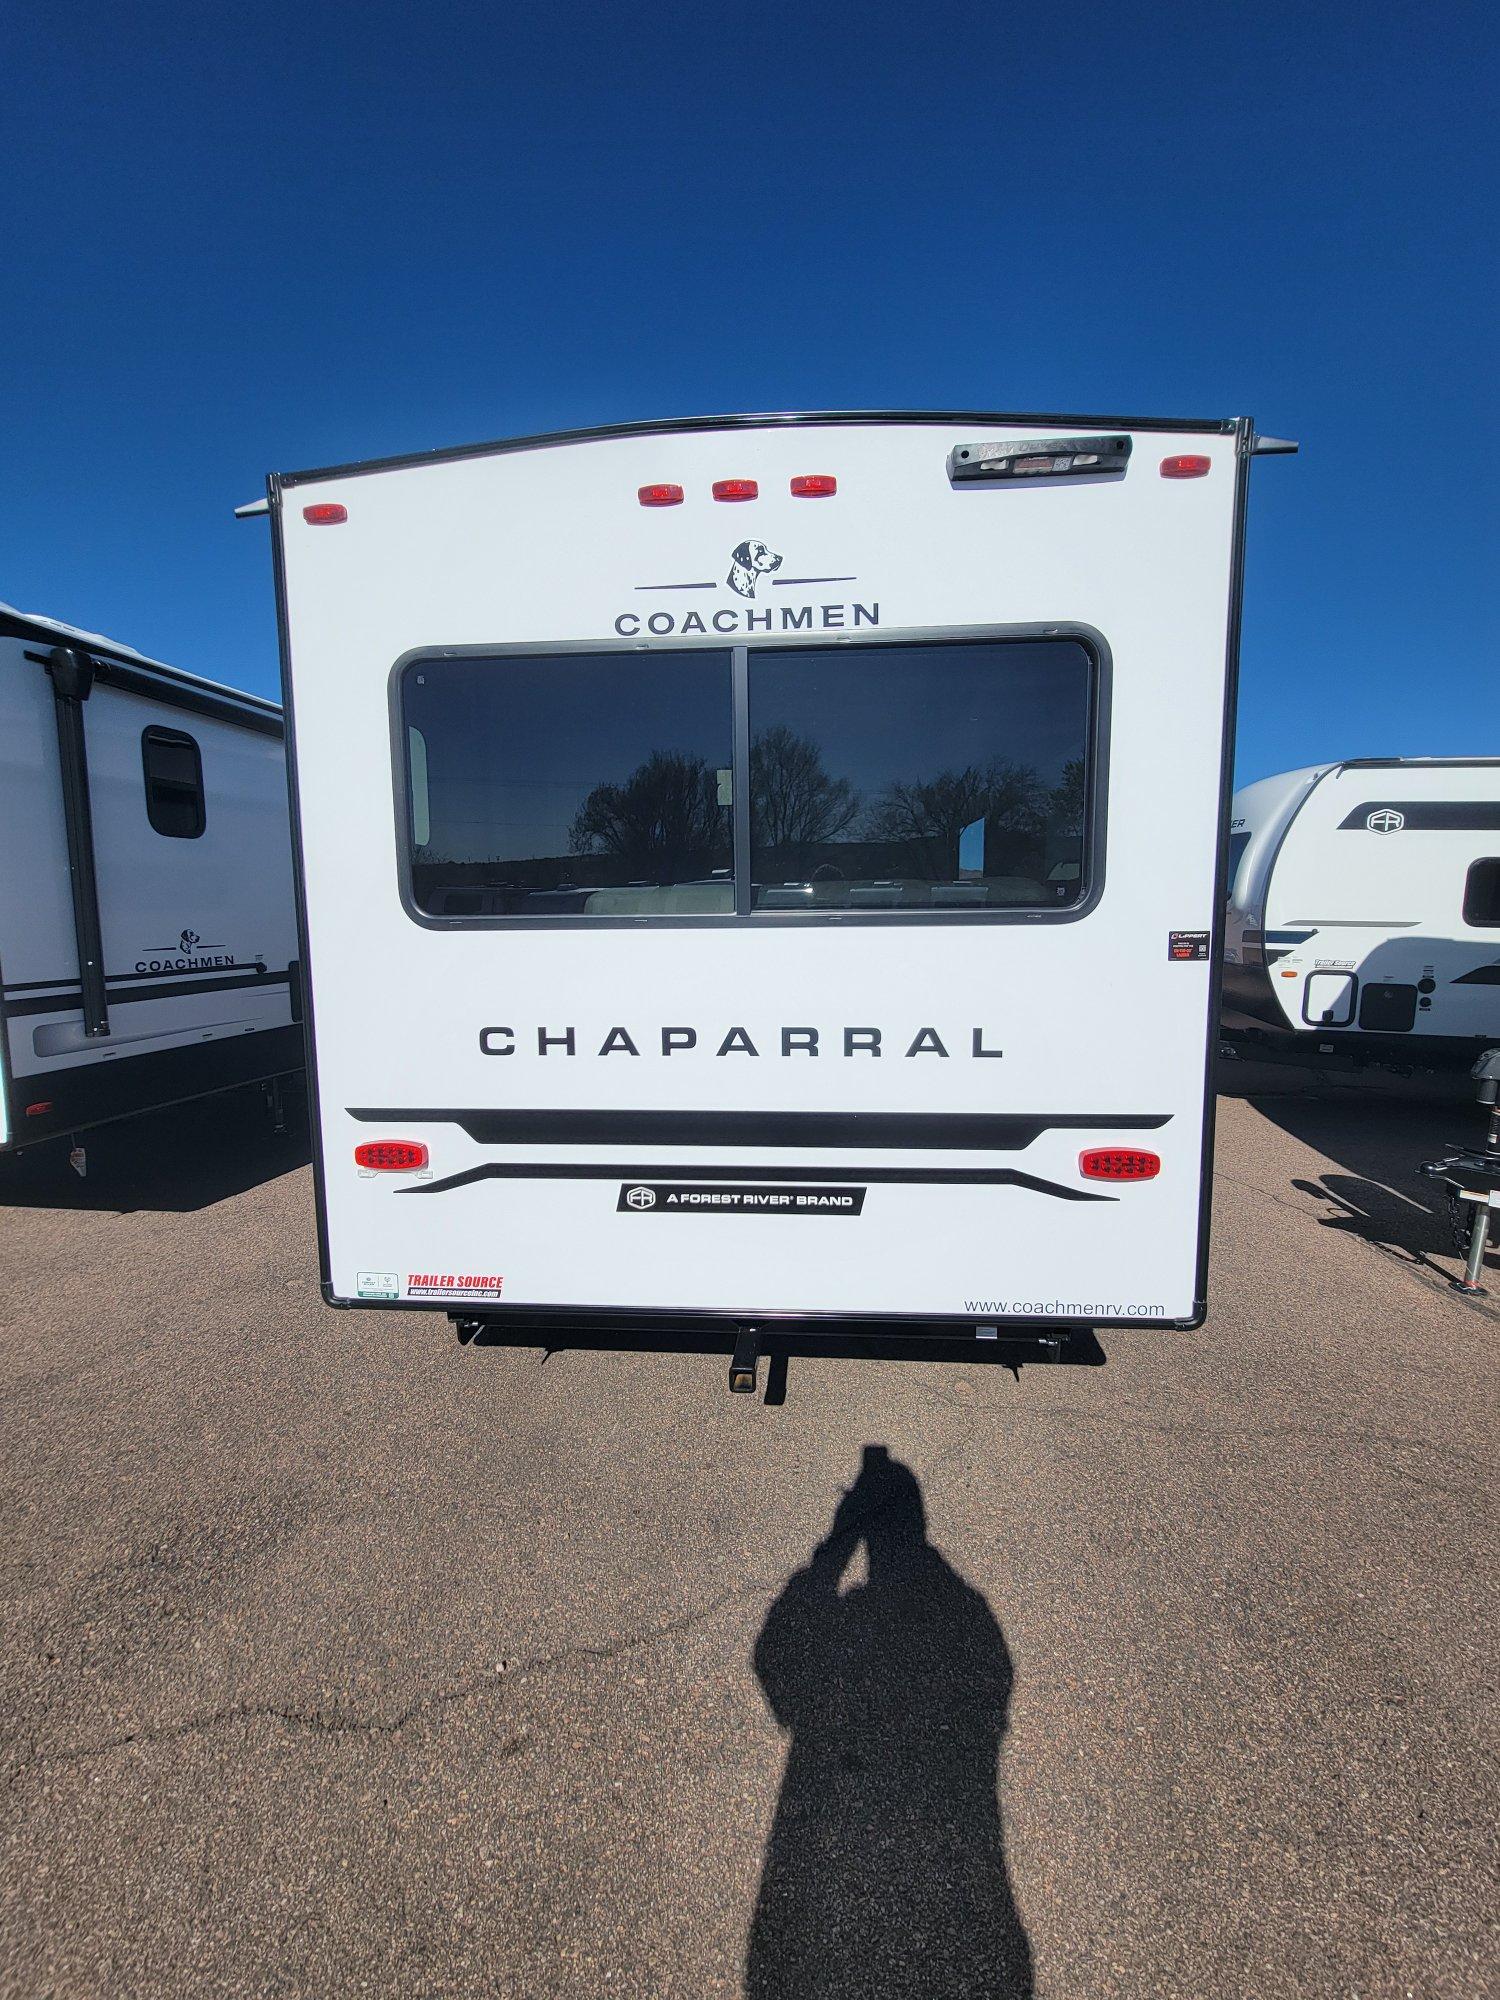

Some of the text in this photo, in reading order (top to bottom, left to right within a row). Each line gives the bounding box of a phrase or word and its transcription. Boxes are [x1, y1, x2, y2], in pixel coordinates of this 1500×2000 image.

[614, 602, 879, 636] COACHMEN
[135, 955, 234, 973] COACHMEN
[478, 1026, 1003, 1059] CHAPARRAL
[666, 1193, 679, 1203] A
[680, 1193, 741, 1205] FOREST
[796, 1195, 853, 1206] BRAND
[407, 1274, 503, 1288] TRAILER SOURCE
[410, 1288, 499, 1297] www.trailersourceinc.com
[964, 1299, 1165, 1316] www.coachmenrv.com
